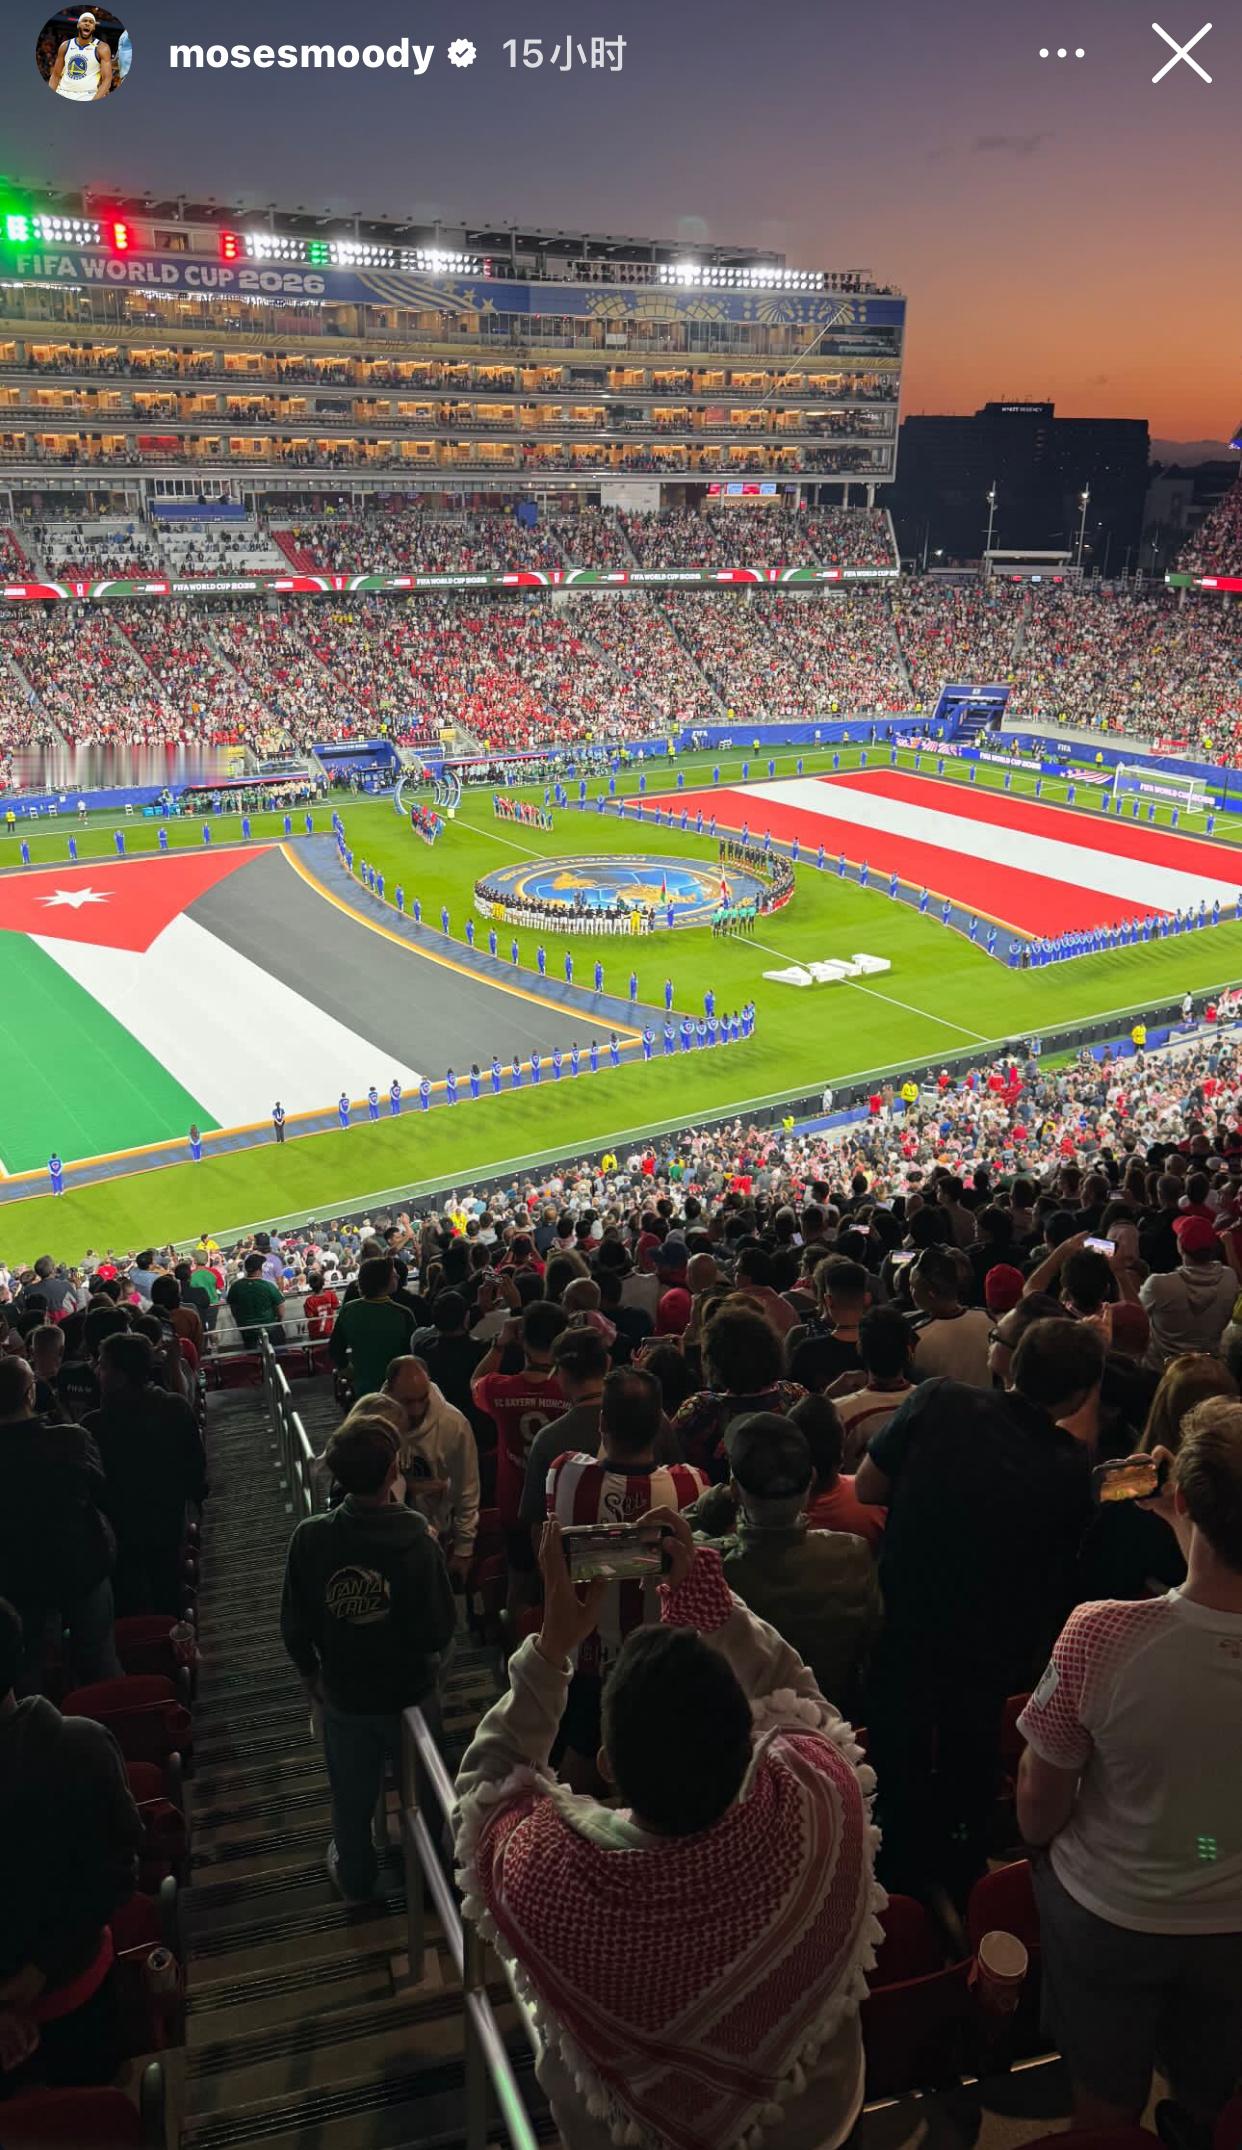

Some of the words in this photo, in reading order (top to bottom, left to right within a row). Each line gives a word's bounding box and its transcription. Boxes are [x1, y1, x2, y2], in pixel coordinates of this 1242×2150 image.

[17, 254, 78, 277] FIFA
[80, 257, 179, 284] WORLD
[184, 265, 234, 287] CUP
[238, 269, 326, 294] 2026
[172, 583, 188, 592] FIFA
[188, 583, 215, 591] WORLD
[216, 582, 231, 590] CUP
[325, 1580, 382, 1603] SANTA
[336, 1597, 382, 1618] CRUZ
